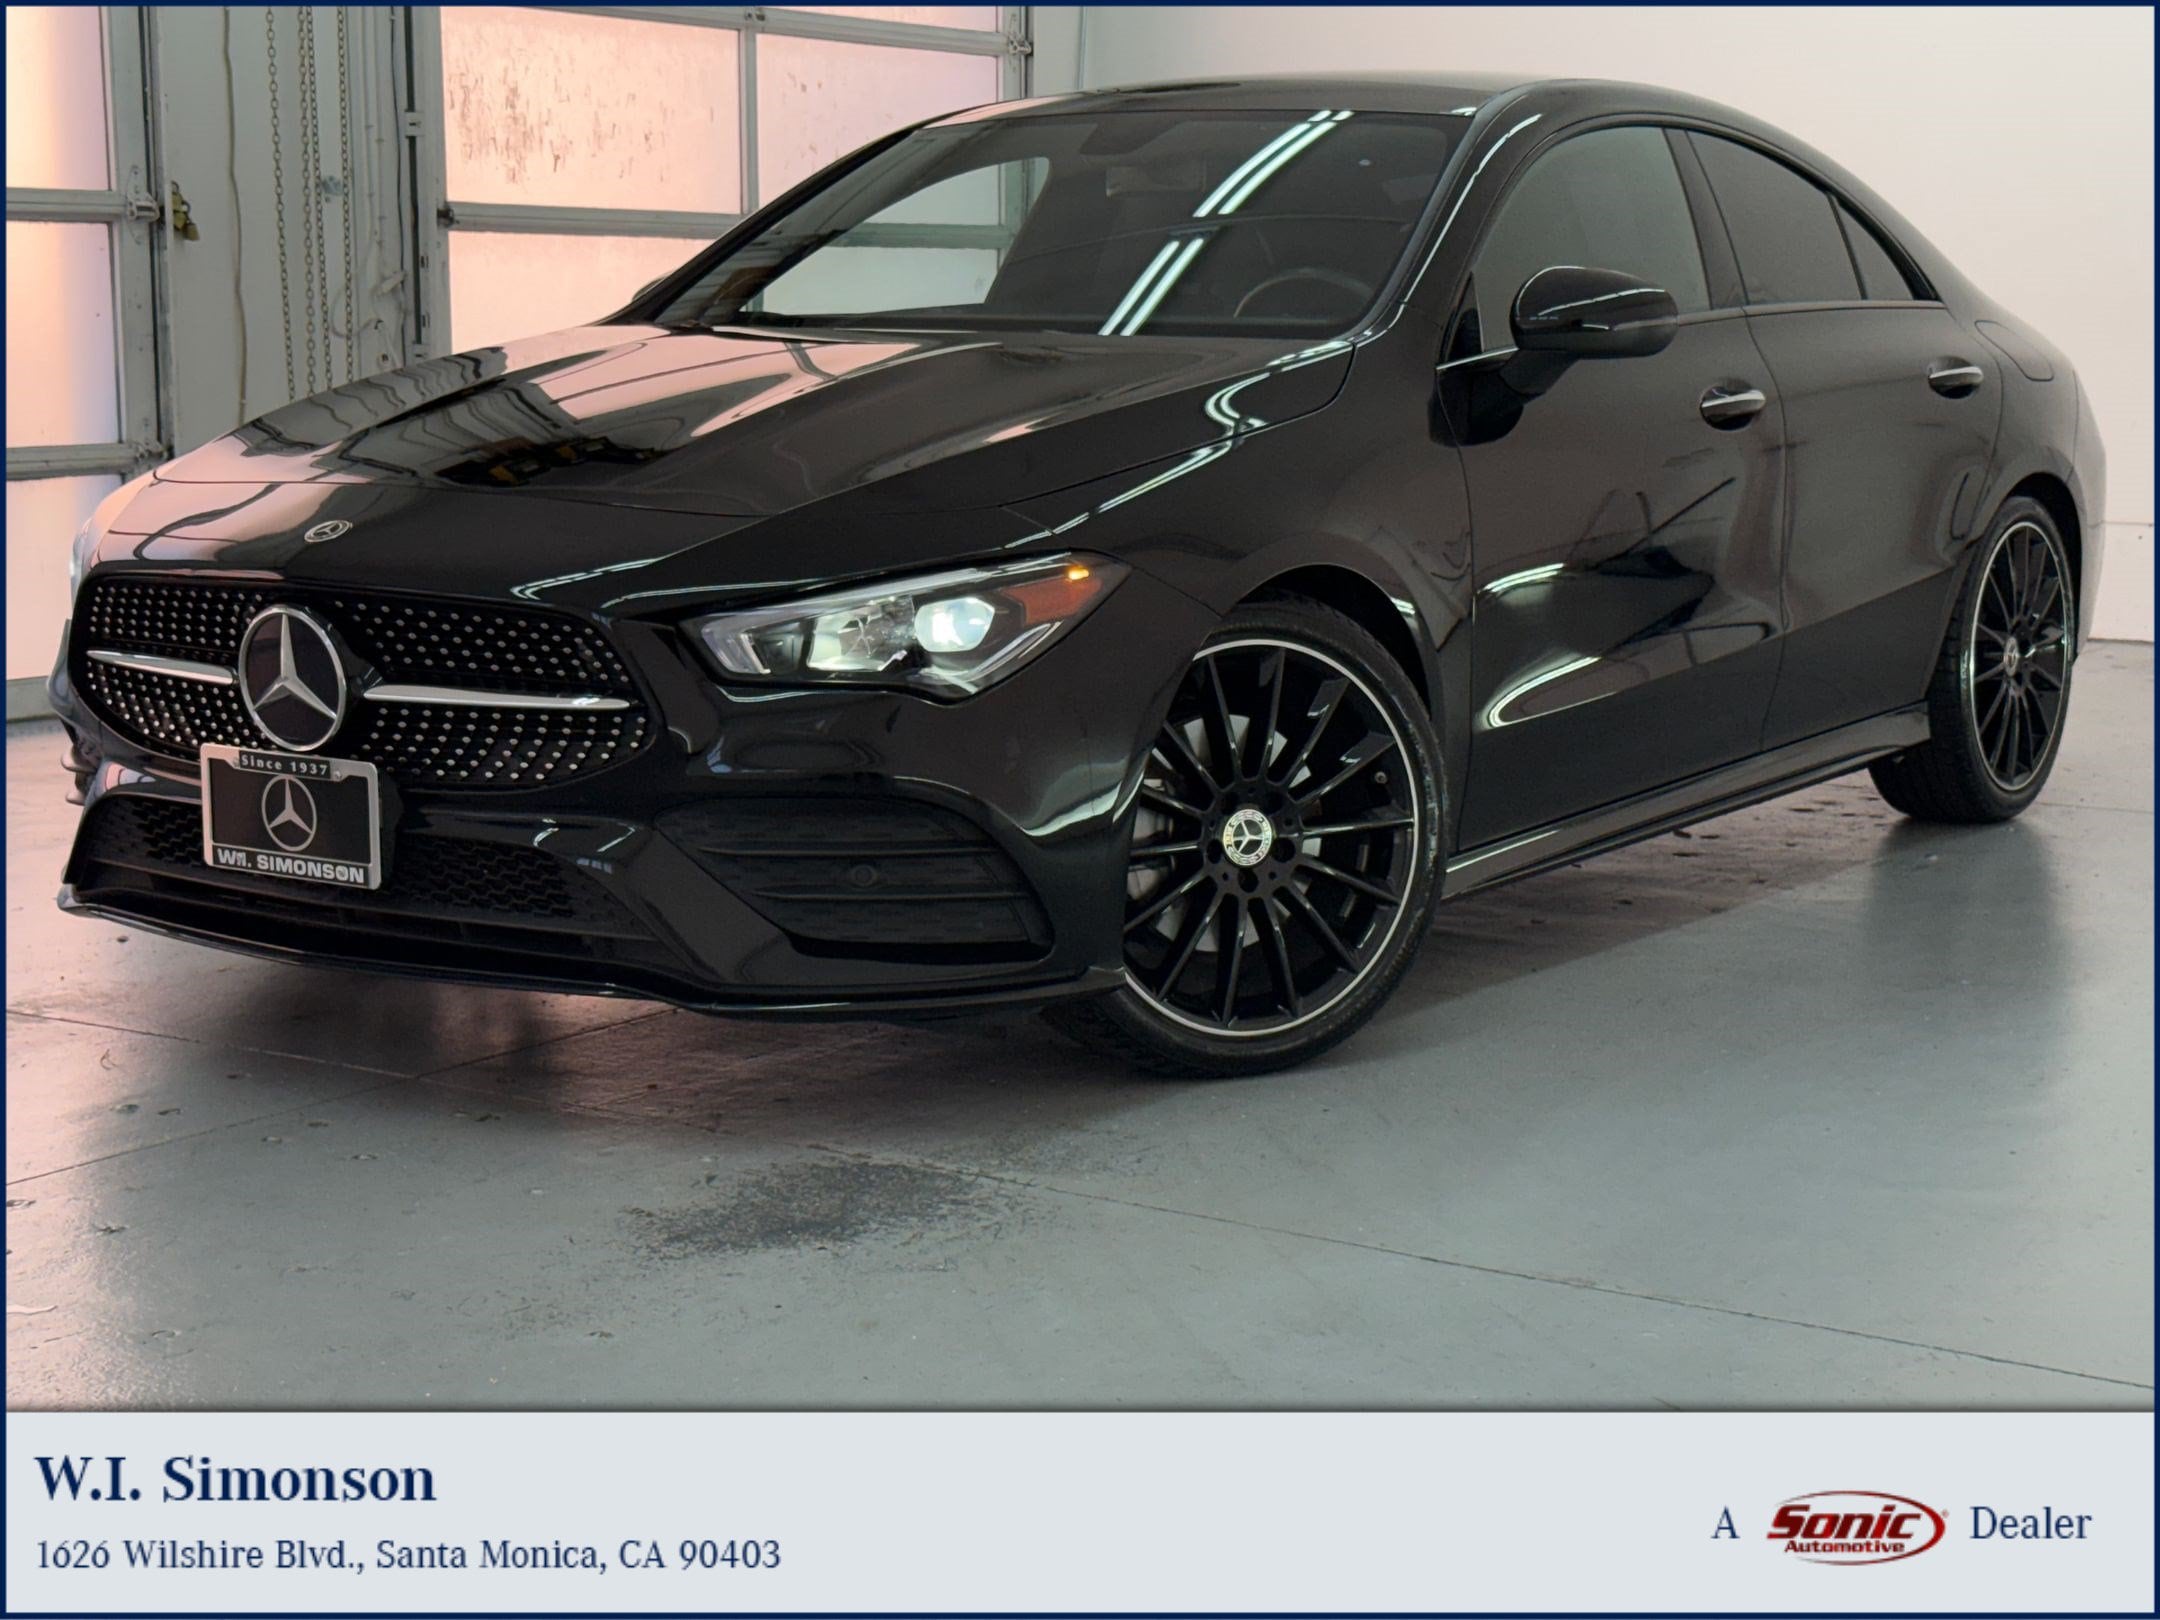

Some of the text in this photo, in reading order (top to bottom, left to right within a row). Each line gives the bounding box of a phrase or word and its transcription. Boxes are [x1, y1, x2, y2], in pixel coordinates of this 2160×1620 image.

[241, 754, 329, 776] Since 1937
[256, 854, 365, 884] SIMONSON
